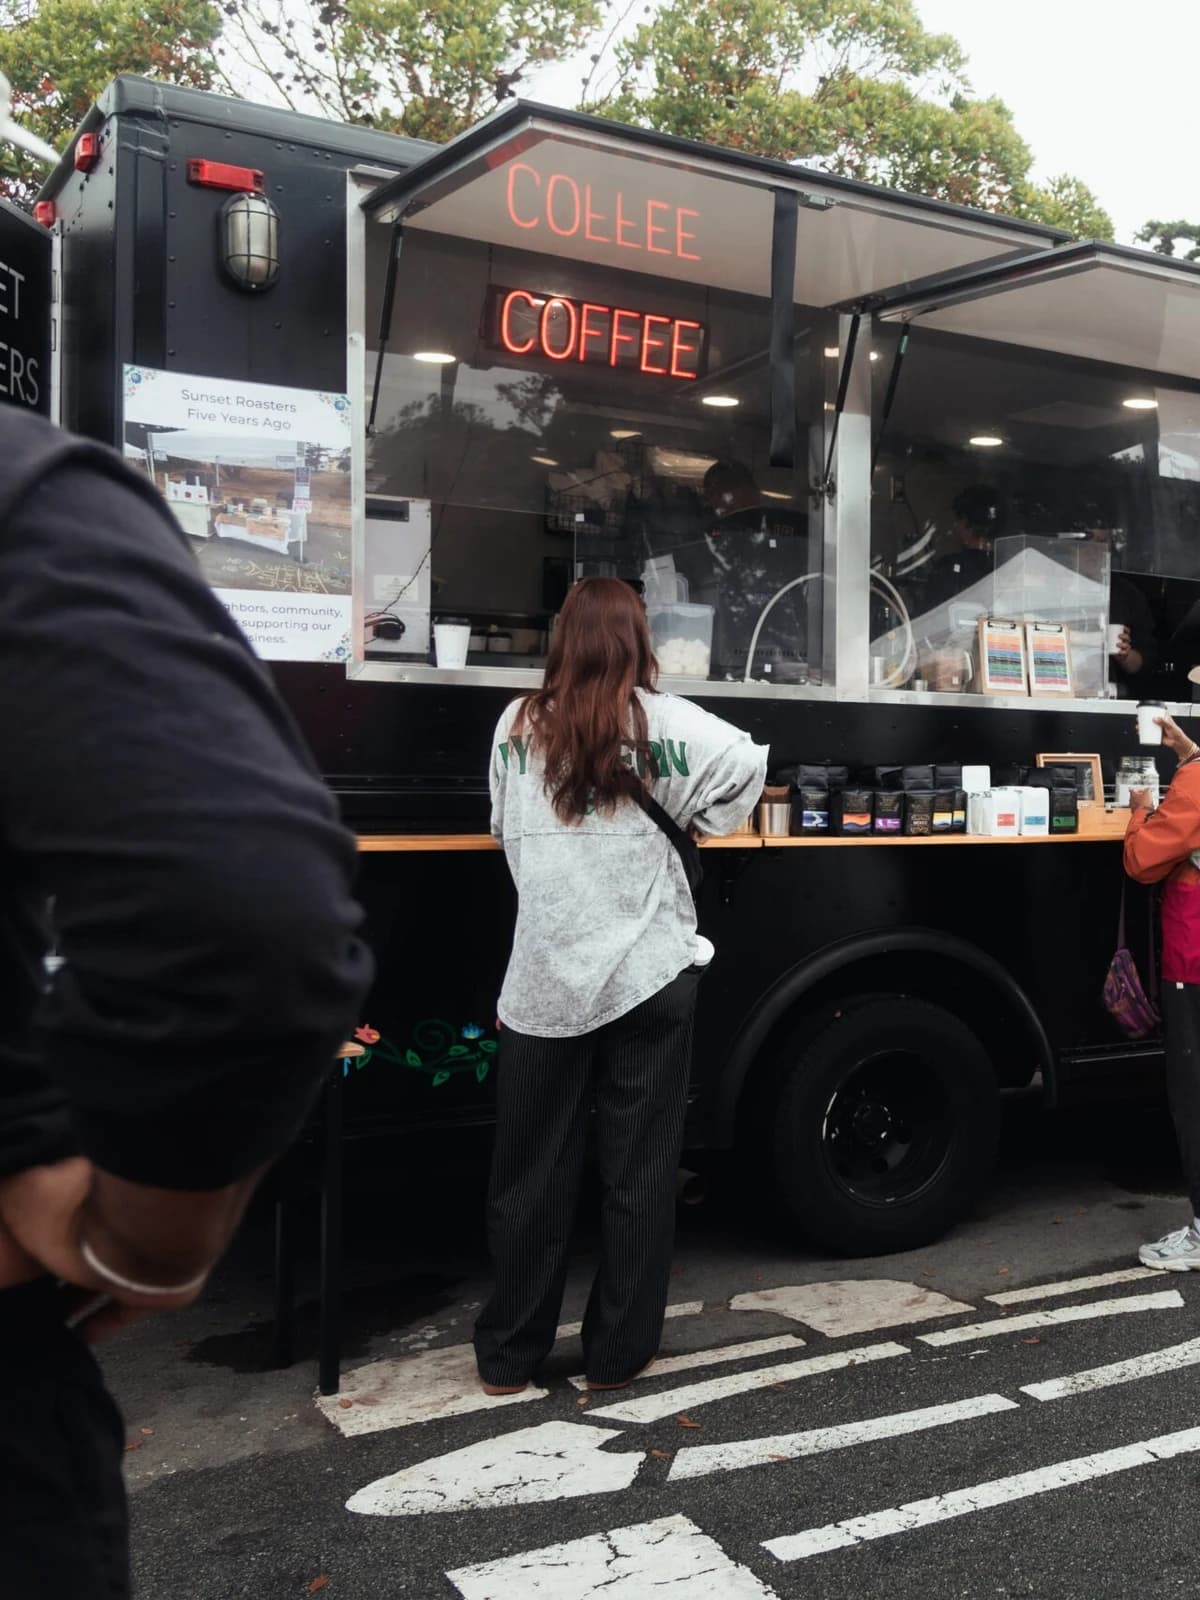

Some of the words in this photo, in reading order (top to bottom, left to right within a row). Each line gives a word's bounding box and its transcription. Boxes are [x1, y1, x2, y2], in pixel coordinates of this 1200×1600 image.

[501, 289, 700, 379] COFFEE
[181, 388, 231, 406] Sunset
[236, 395, 297, 413] Roasters
[187, 407, 217, 422] Five
[220, 411, 260, 427] Years
[262, 416, 292, 431] Ago
[271, 605, 344, 620] community,
[241, 619, 309, 632] supporting
[311, 622, 332, 631] our
